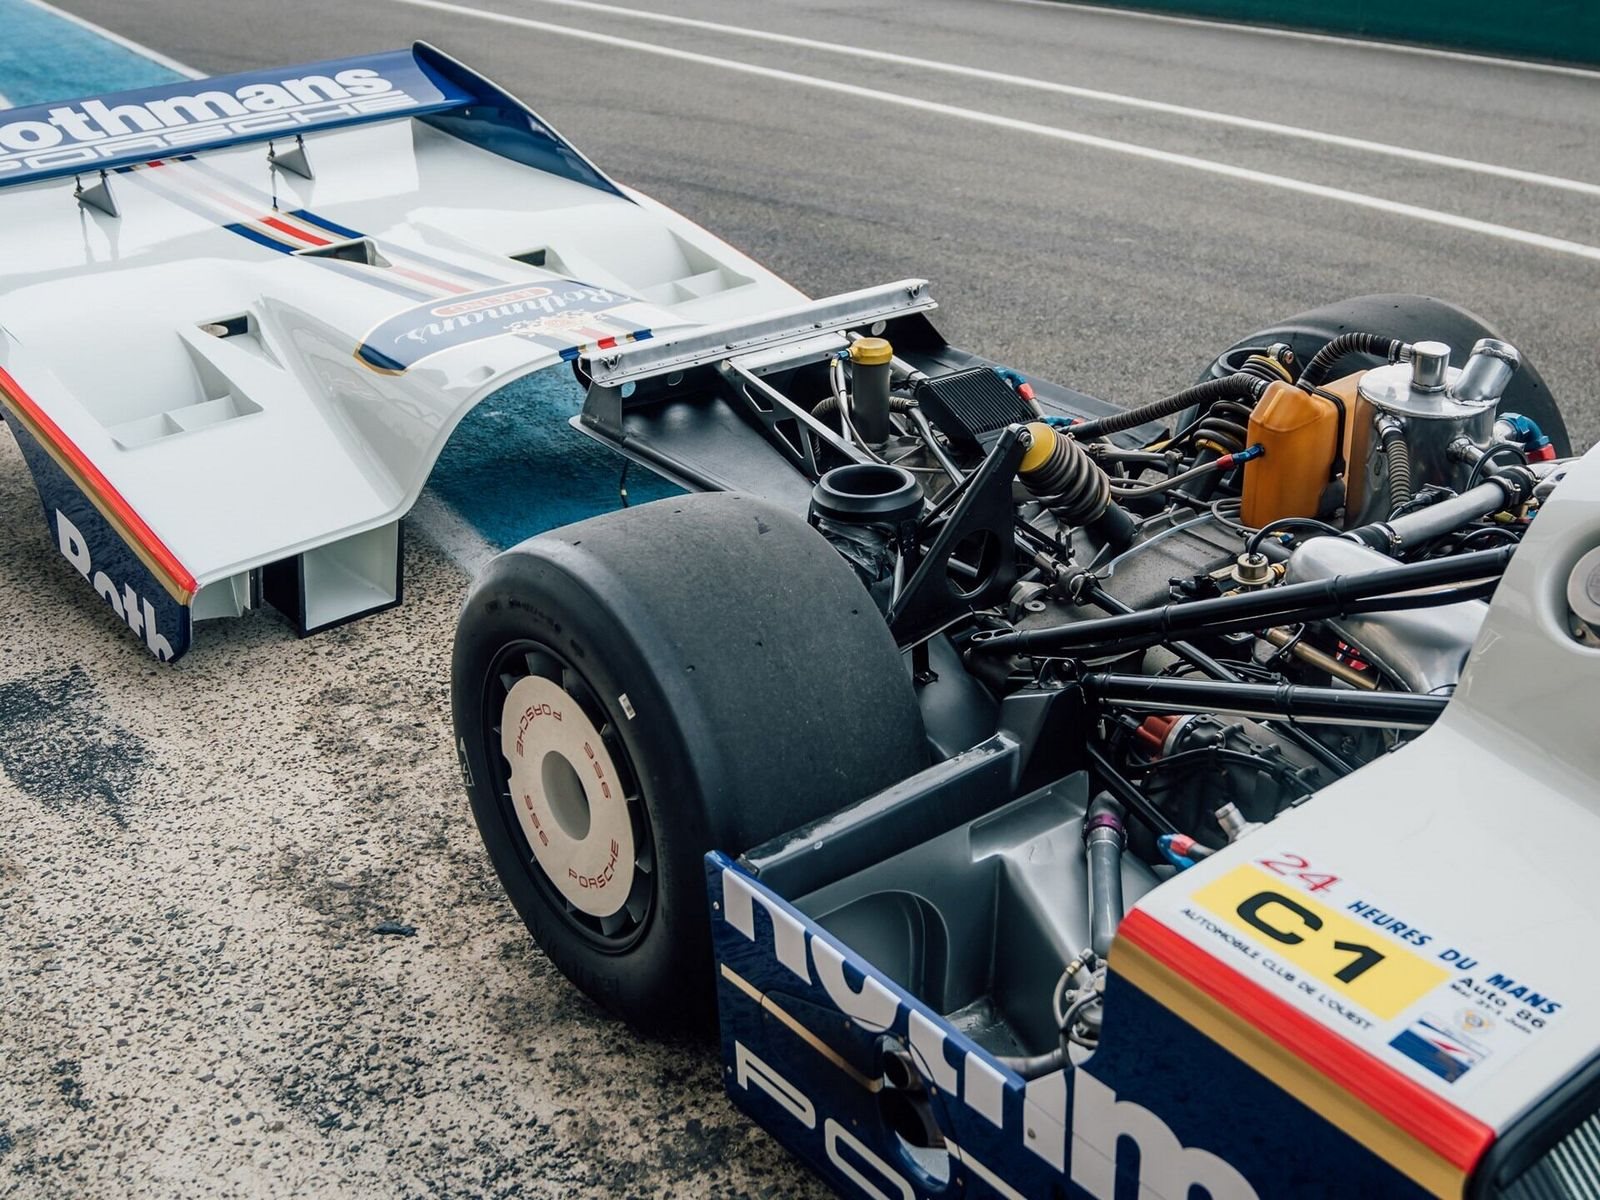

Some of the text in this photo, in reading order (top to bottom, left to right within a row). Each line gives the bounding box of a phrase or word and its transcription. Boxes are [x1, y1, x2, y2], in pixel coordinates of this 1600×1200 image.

[0, 69, 392, 154] othmans
[394, 288, 632, 345] Rothmans
[516, 703, 562, 757] PORSCHE
[568, 838, 619, 889] PORSCHE
[1181, 907, 1258, 959] AUTOMOBILE
[1261, 958, 1296, 983] CLUB
[1298, 981, 1316, 995] DE
[1256, 853, 1562, 1014] 24 HEURES DU MANS
[1459, 978, 1546, 1029] Auto 86
